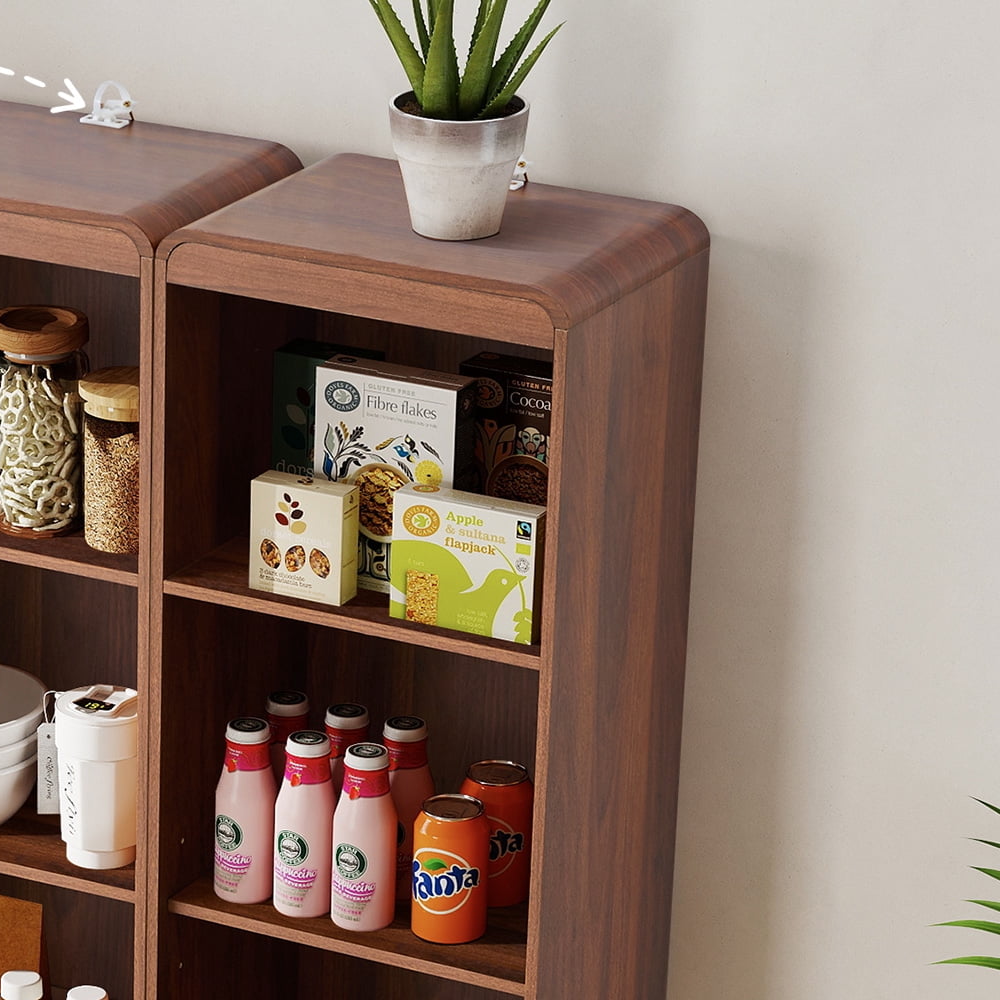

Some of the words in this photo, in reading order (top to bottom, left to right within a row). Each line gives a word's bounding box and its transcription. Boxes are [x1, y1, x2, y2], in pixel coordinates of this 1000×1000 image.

[367, 395, 398, 413] Fibre
[401, 400, 438, 420] flakes
[510, 392, 552, 412] Cocoa
[446, 511, 484, 526] Apple
[446, 524, 456, 535] &
[458, 528, 506, 544] sultana
[444, 537, 496, 556] flapjack
